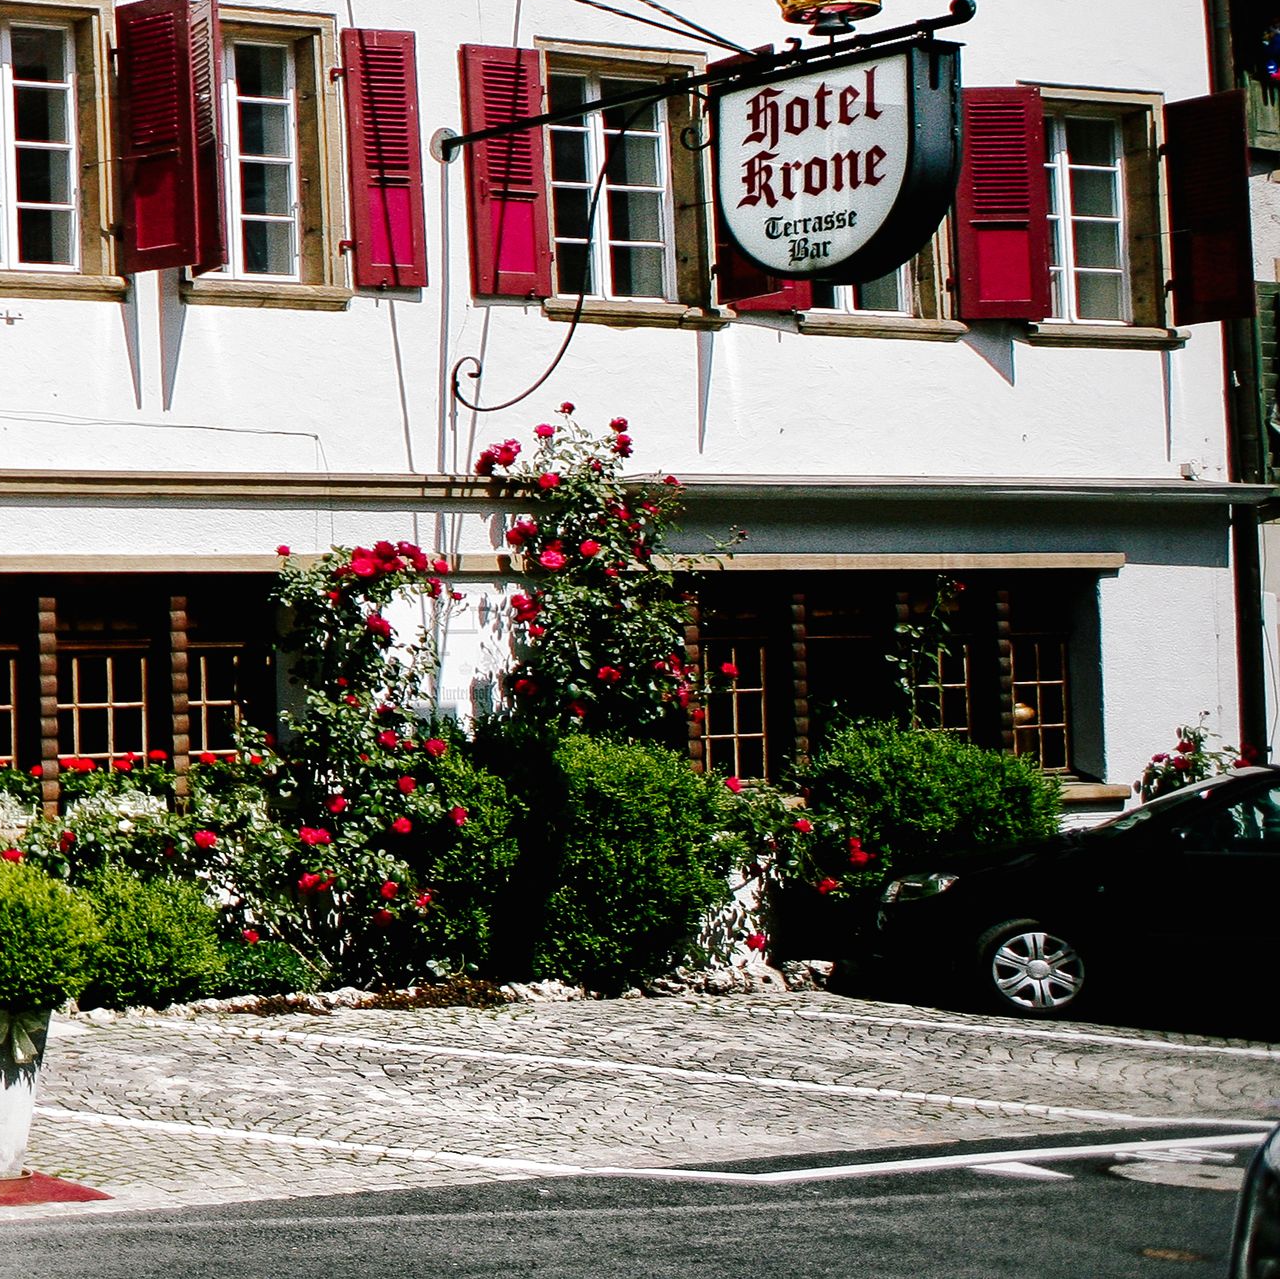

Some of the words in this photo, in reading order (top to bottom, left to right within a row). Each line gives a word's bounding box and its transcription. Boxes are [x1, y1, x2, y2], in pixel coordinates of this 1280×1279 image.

[741, 65, 883, 150] Hotel
[736, 144, 887, 209] Krone
[764, 209, 858, 240] Terrasse
[788, 236, 832, 266] Bar
